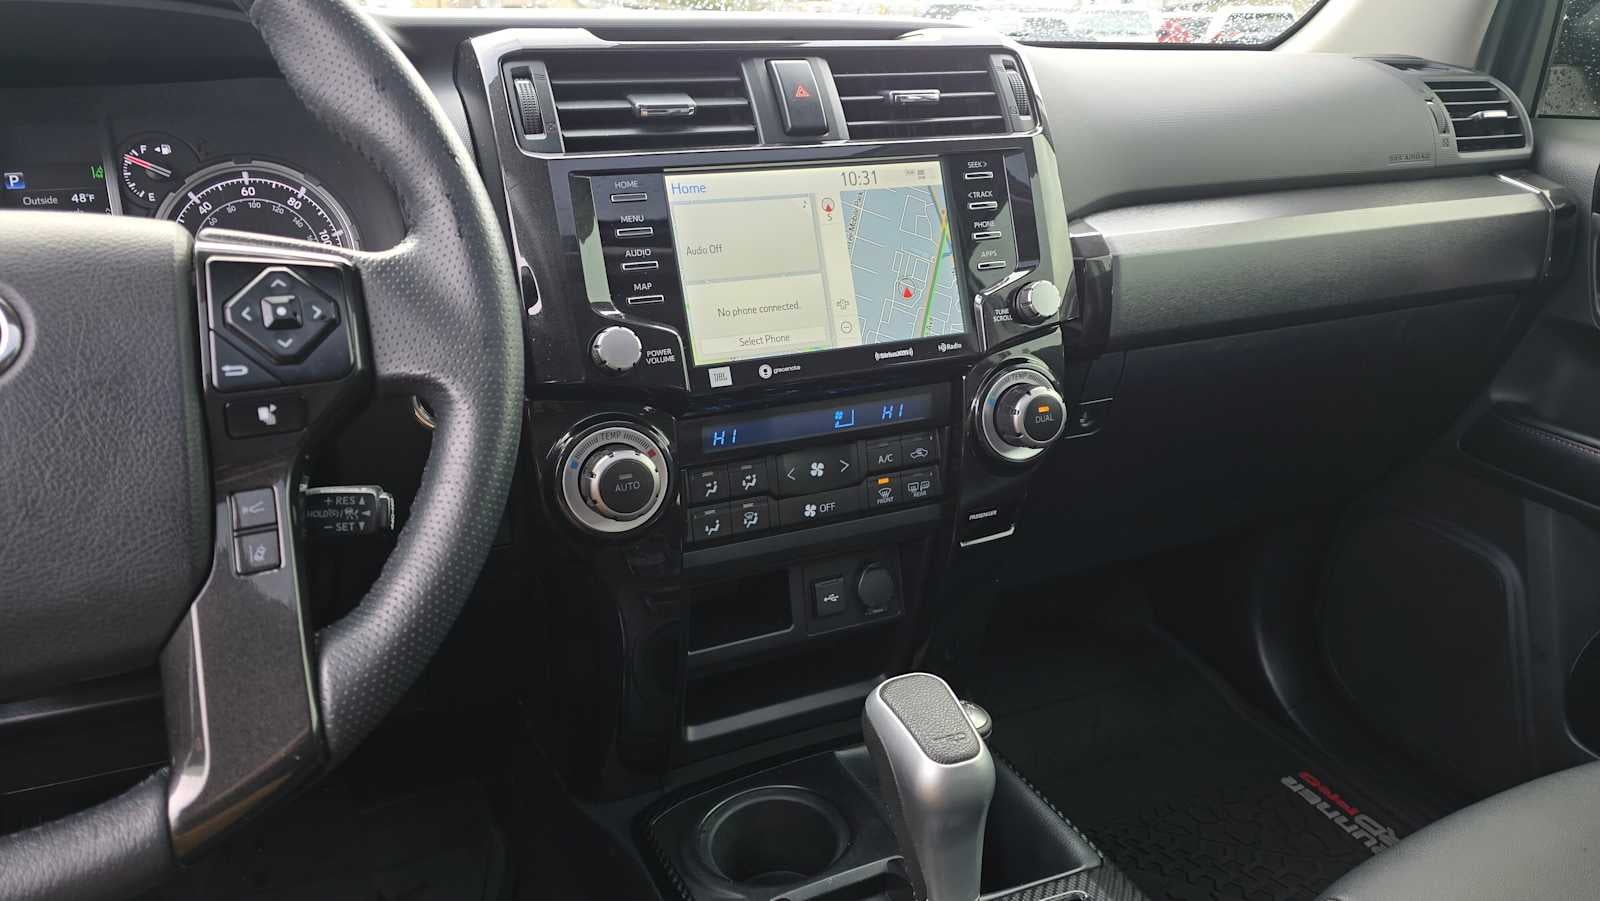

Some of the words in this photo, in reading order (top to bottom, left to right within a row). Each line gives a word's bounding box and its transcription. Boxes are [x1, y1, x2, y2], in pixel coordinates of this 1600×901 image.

[140, 145, 147, 154] F
[841, 169, 878, 186] 10:31
[614, 181, 640, 189] HOME
[671, 182, 706, 196] Home
[241, 187, 256, 197] 60
[23, 196, 58, 206] Outside
[148, 193, 155, 202] E
[199, 201, 212, 215] 40
[287, 197, 302, 210] 80
[272, 204, 284, 215] 120
[620, 215, 645, 223] MENU
[974, 221, 995, 229] PHONE
[625, 249, 651, 258] AUDIO
[686, 246, 708, 256] Audio
[709, 244, 723, 255] Off
[981, 250, 998, 258] APPS
[634, 283, 653, 291] MAP
[718, 307, 731, 317] No
[732, 306, 757, 317] phone
[993, 315, 1013, 323] SCROLL
[739, 337, 763, 347] Select
[765, 334, 790, 345] Phone
[647, 348, 672, 357] POWER
[646, 355, 676, 364] VOLUME
[1035, 415, 1055, 424] DUAL
[600, 431, 622, 440] TEMP
[878, 453, 894, 464] A/C
[615, 481, 641, 492] AUTO
[336, 496, 355, 505] RES
[877, 496, 894, 504] FRONT
[820, 502, 836, 512] OFF
[336, 522, 355, 531] SET
